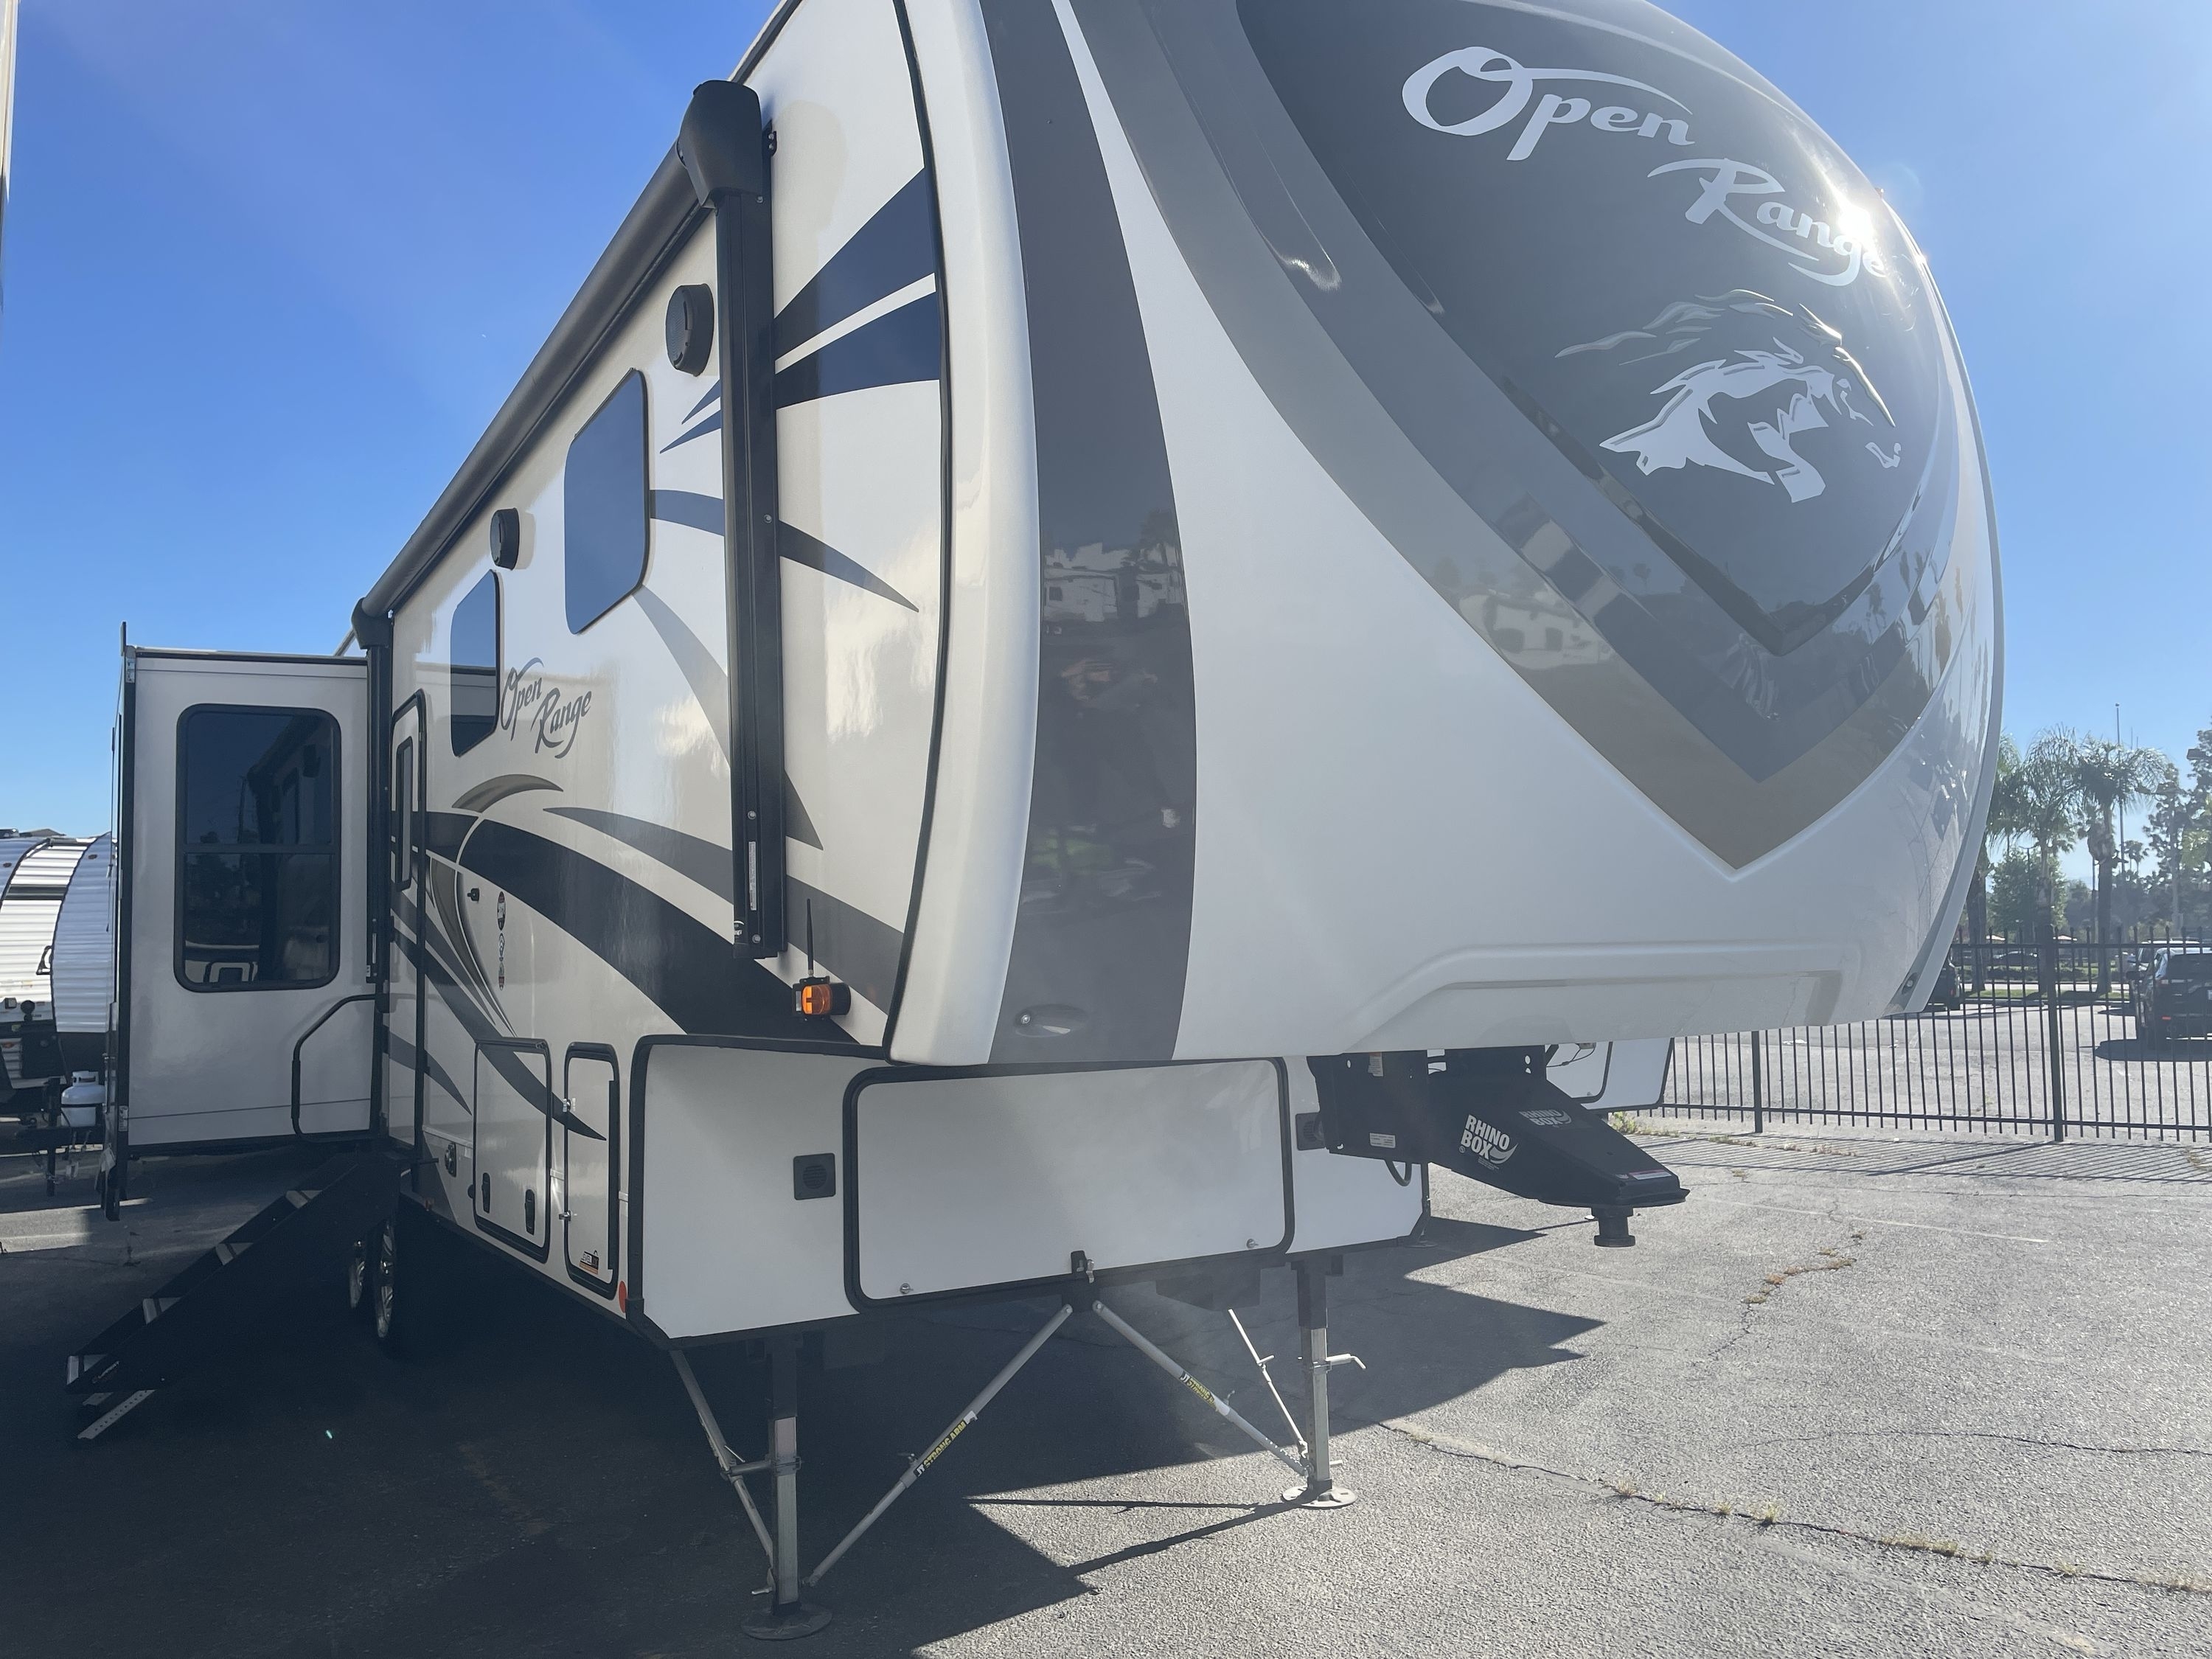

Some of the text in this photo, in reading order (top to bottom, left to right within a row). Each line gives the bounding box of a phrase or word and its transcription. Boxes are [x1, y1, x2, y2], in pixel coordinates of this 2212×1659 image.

[1402, 46, 1695, 161] Open
[1647, 158, 1888, 286] Range
[501, 657, 544, 742] Open
[530, 687, 592, 759] Range
[1465, 1114, 1510, 1150] RHINO
[1519, 1109, 1562, 1119] RHINO
[1529, 1116, 1563, 1126] BOX
[1461, 1129, 1495, 1160] BOX
[923, 1437, 952, 1468] STRONG
[950, 1420, 967, 1441] ARM
